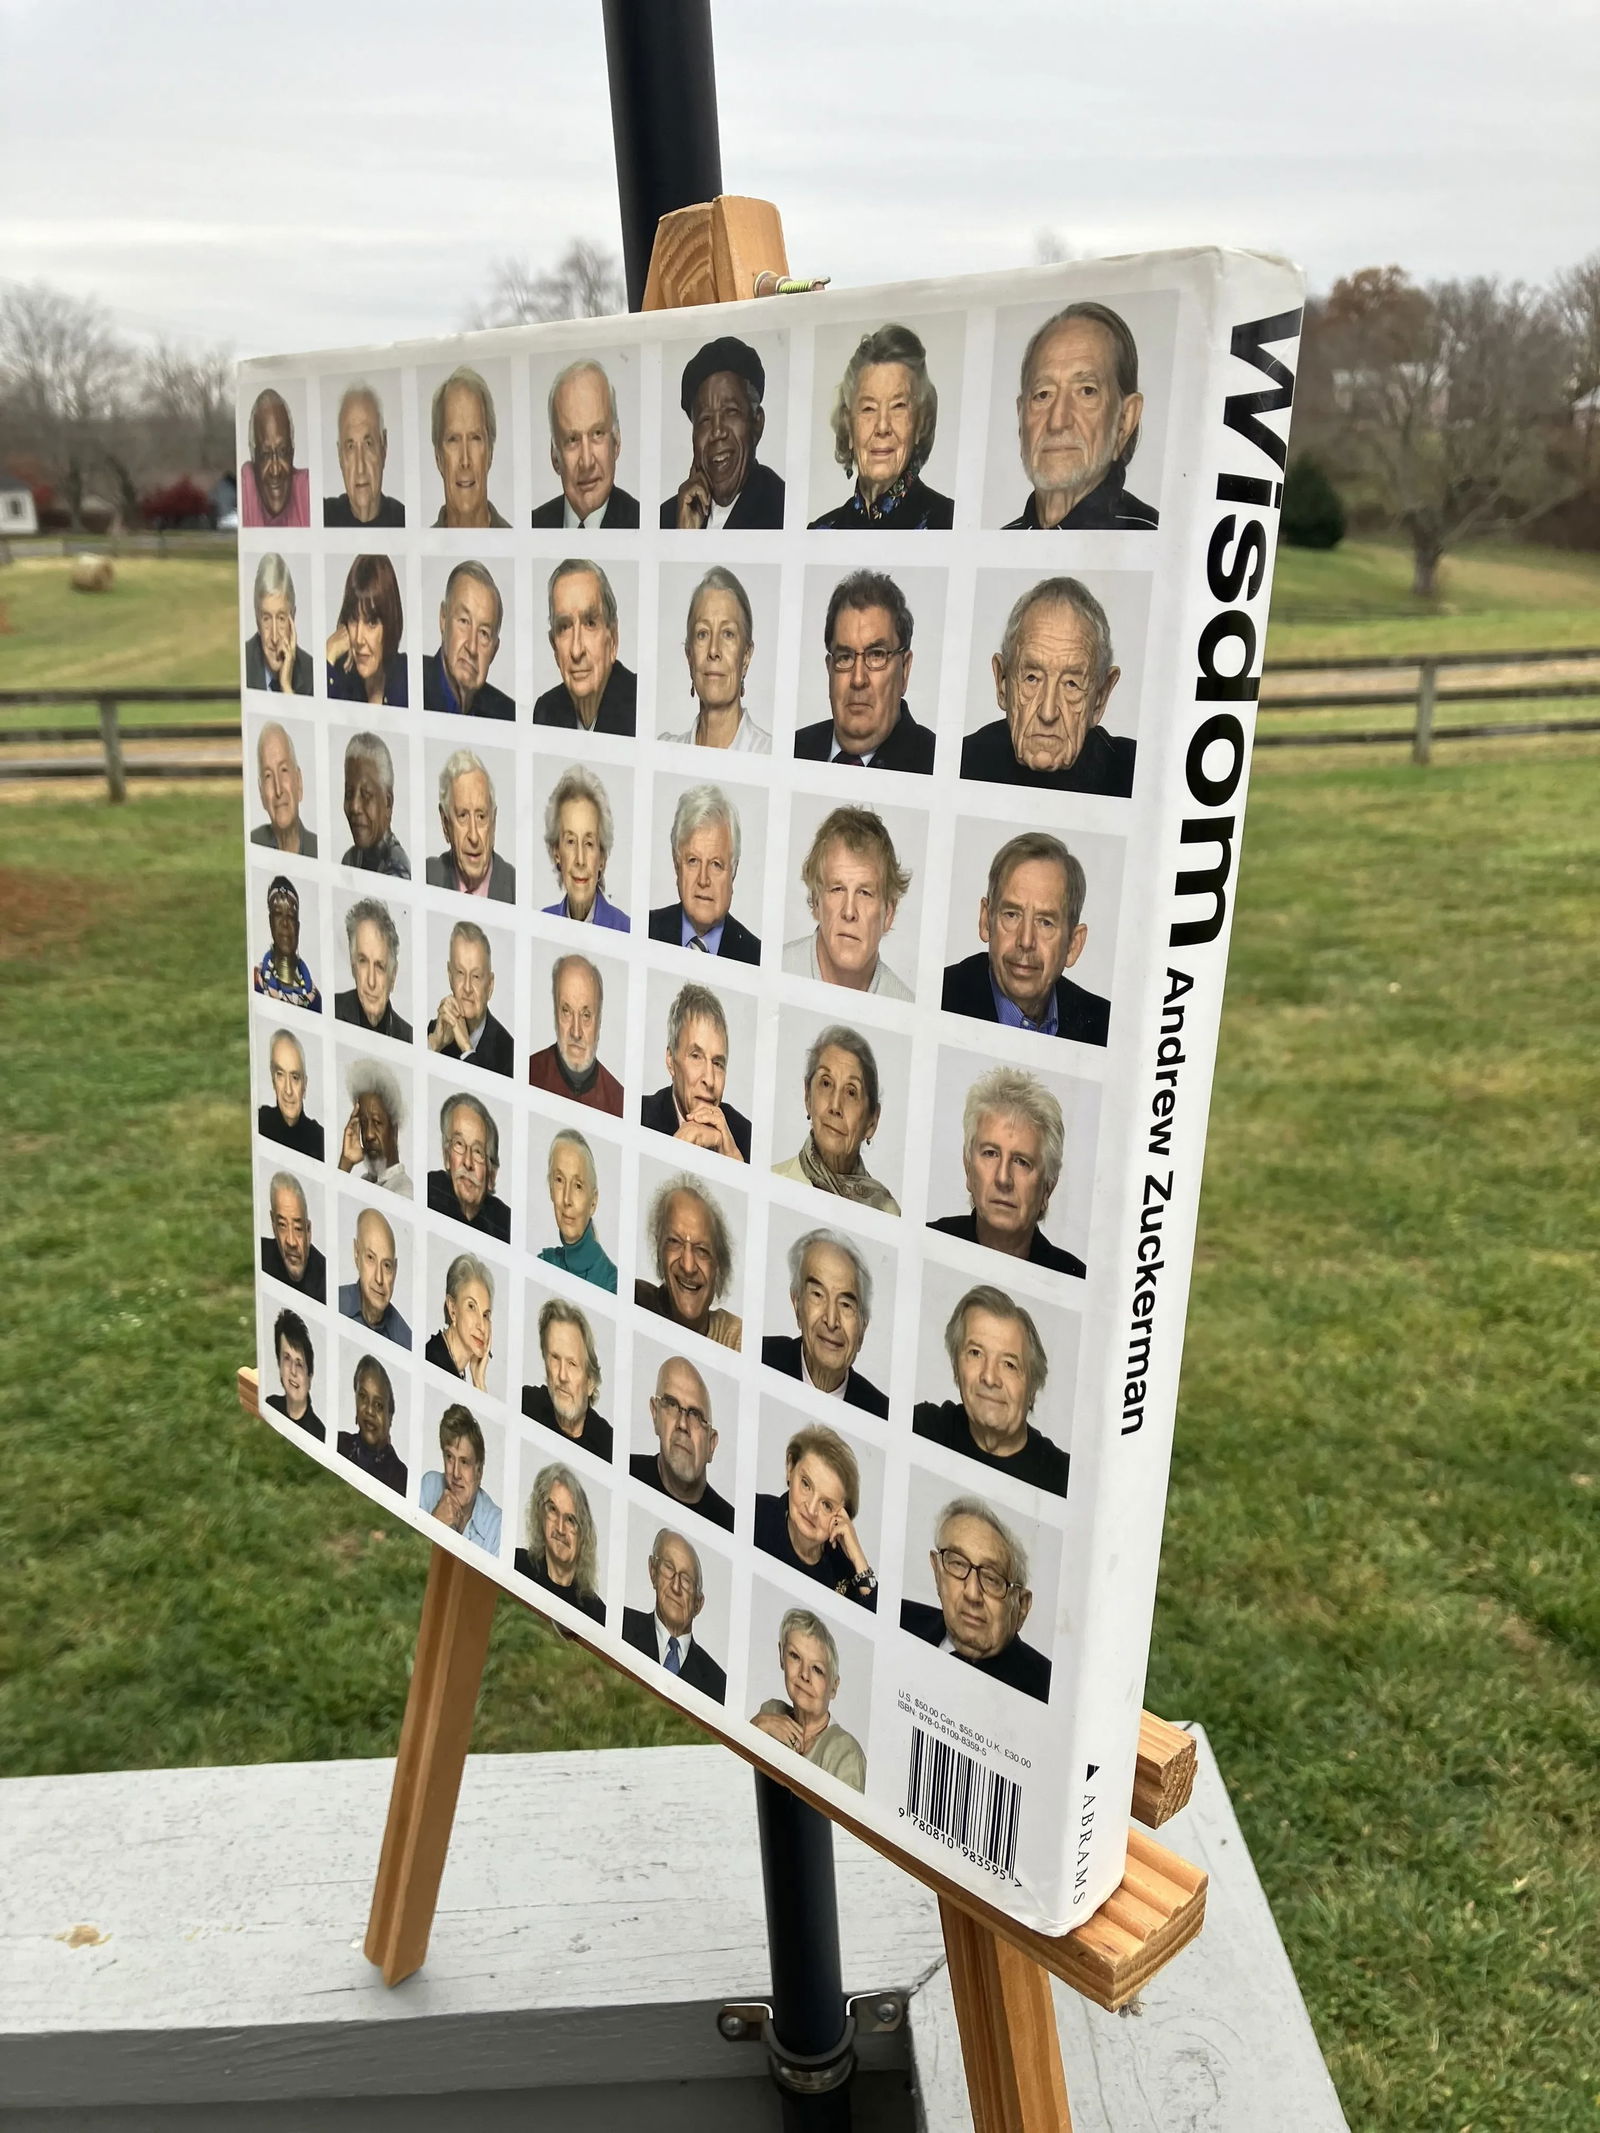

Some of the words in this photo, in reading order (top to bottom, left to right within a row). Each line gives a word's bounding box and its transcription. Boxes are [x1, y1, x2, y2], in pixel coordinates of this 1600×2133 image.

[1169, 307, 1304, 948] Wisdom
[1147, 966, 1195, 1157] Andrew
[1120, 1170, 1174, 1436] Zuckerman
[898, 1688, 913, 1704] U.S.
[914, 1698, 939, 1718] $50.00
[940, 1712, 957, 1728] Can.
[959, 1723, 985, 1744] $55.00
[986, 1738, 1002, 1754] U.K.
[1004, 1748, 1032, 1769] £30.00
[918, 1711, 987, 1757] 978-0-8109-8359-5
[898, 1807, 905, 1818] 9
[911, 1815, 954, 1849] 780810
[962, 1846, 1006, 1881] 983595
[1072, 1793, 1097, 1905] ABRAMS
